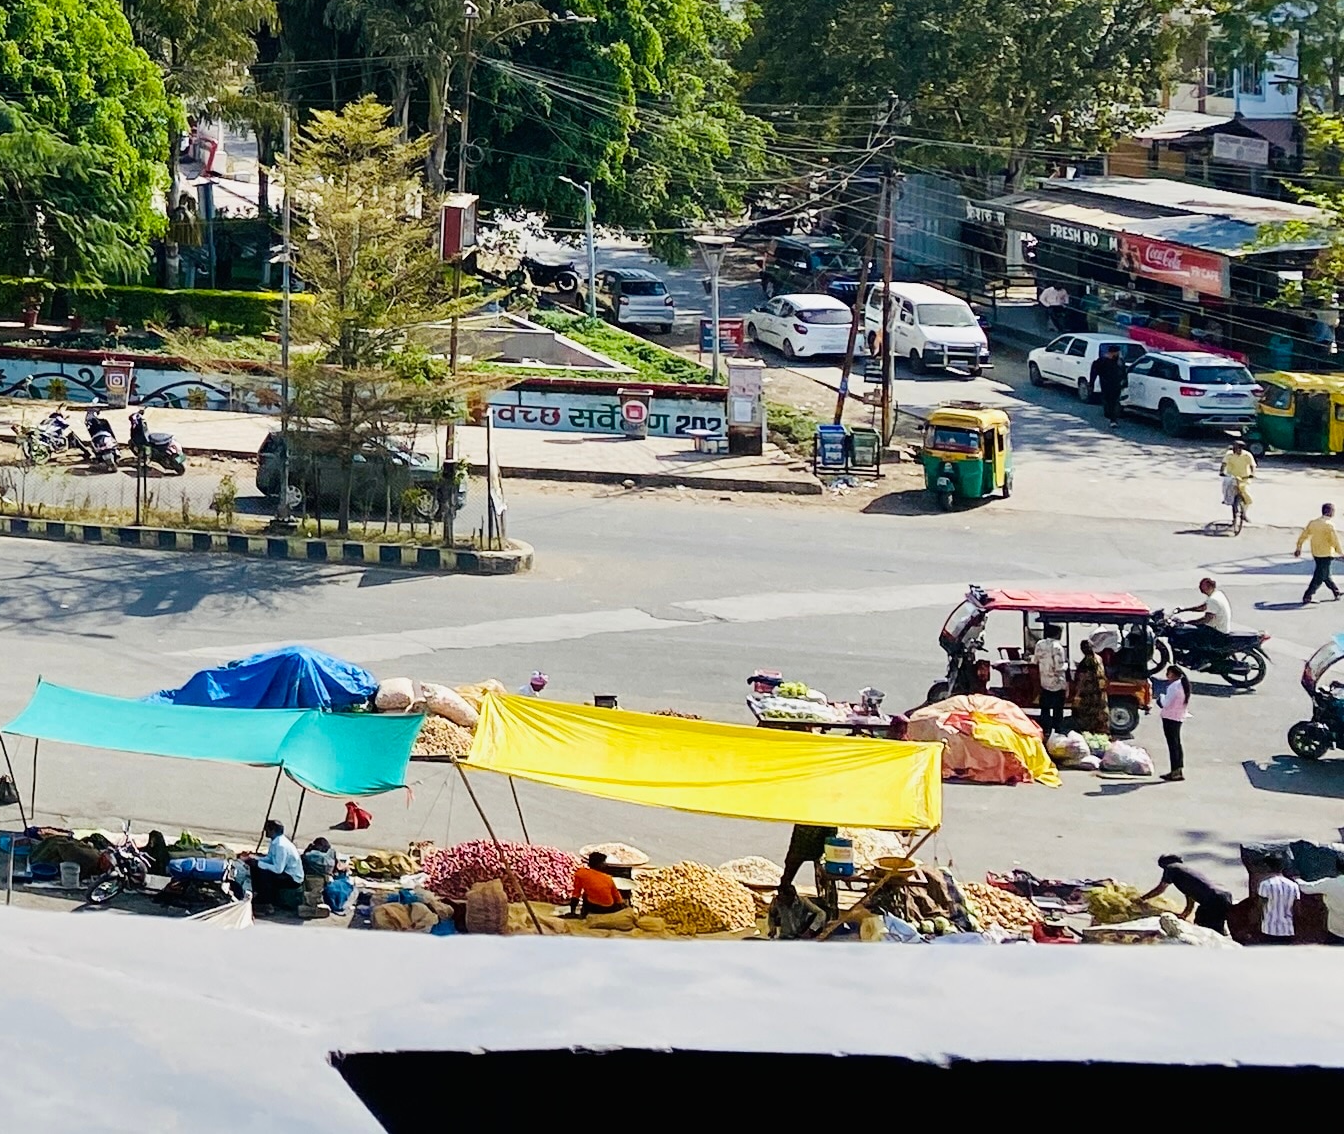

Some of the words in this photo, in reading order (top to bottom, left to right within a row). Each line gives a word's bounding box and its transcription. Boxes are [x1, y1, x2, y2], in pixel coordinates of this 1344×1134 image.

[1050, 223, 1082, 245] FRESH
[492, 404, 561, 427] वच्छ
[675, 414, 728, 438] 202
